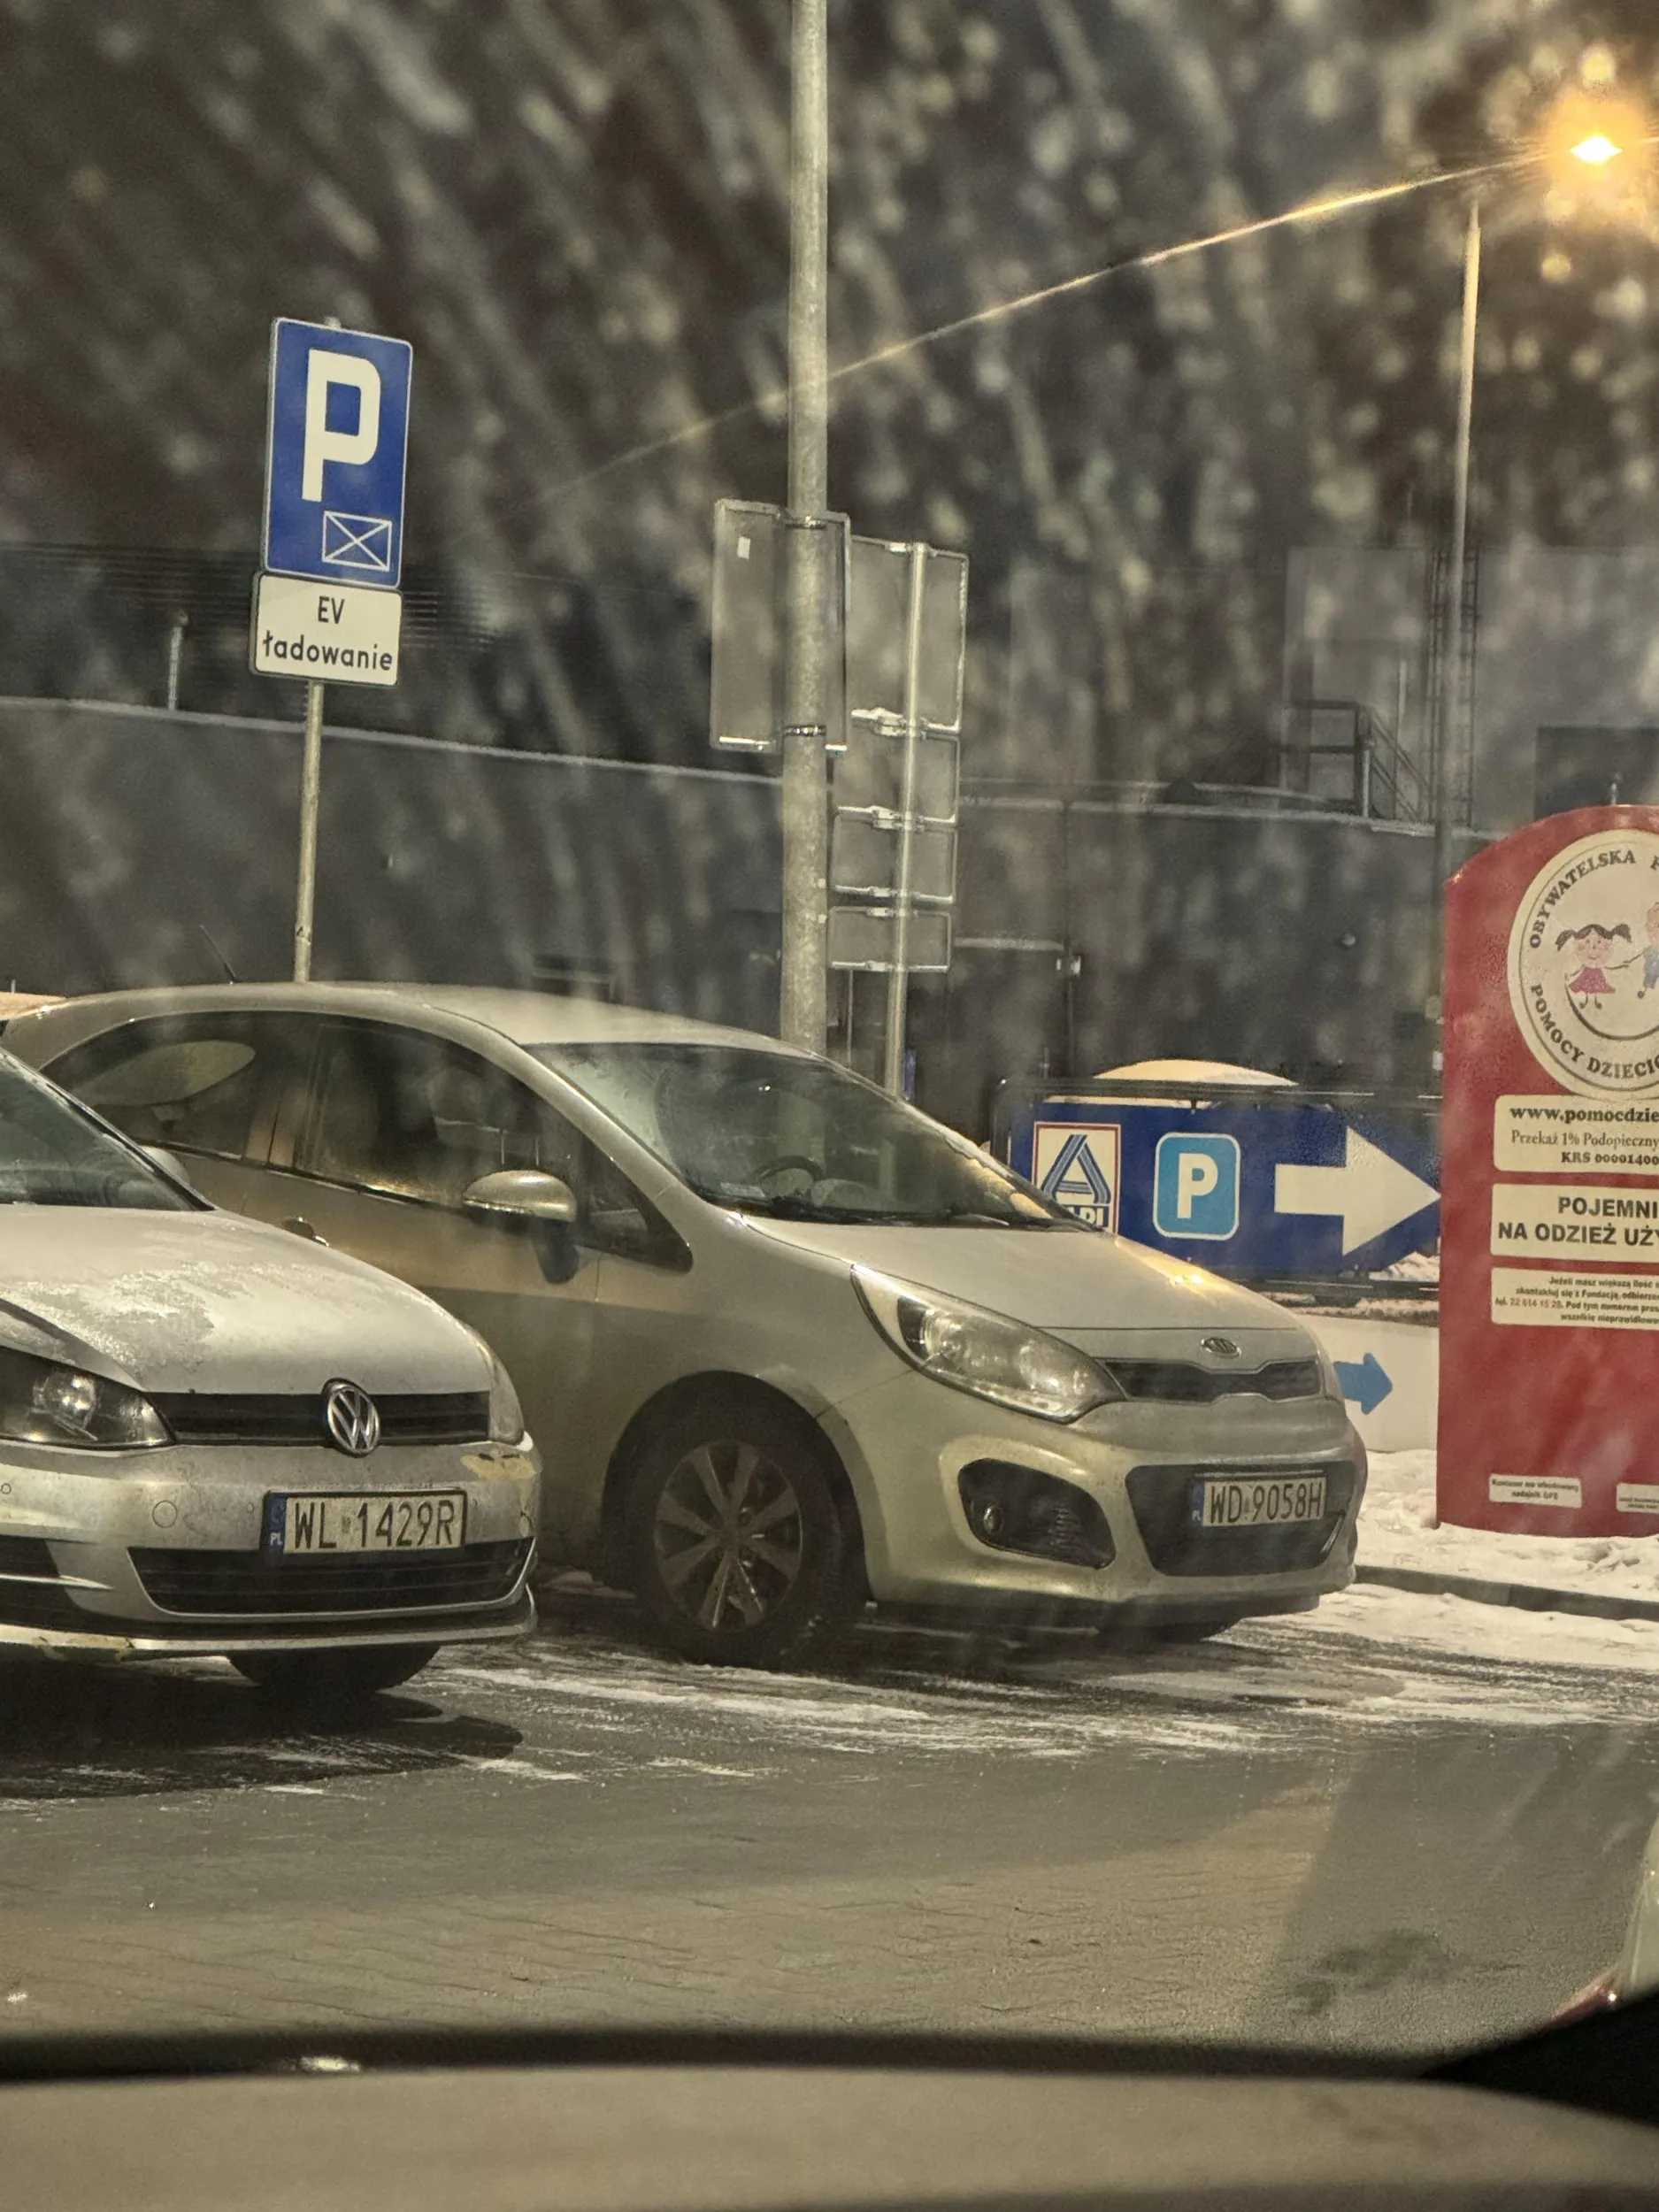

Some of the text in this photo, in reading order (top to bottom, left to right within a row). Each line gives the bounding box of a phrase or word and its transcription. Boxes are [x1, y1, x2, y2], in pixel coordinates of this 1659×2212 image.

[302, 348, 380, 502] P
[317, 595, 345, 625] EV
[262, 630, 393, 672] ładowanie
[1530, 849, 1636, 949] OBYWATELSKA
[1531, 982, 1585, 1063] POMOCY
[1511, 1129, 1558, 1145] Przekaż
[1562, 1132, 1580, 1146] 1%
[1561, 1151, 1591, 1164] KRS
[1177, 1153, 1218, 1219] P
[1558, 1195, 1659, 1219] POJEMNI
[1498, 1221, 1528, 1240] NA
[1534, 1222, 1617, 1245] ODZIEŻ
[1565, 1301, 1581, 1310] Pod
[1210, 1482, 1322, 1524] WD 9058H
[270, 1532, 283, 1547] PL
[295, 1500, 455, 1548] WL 1429R
